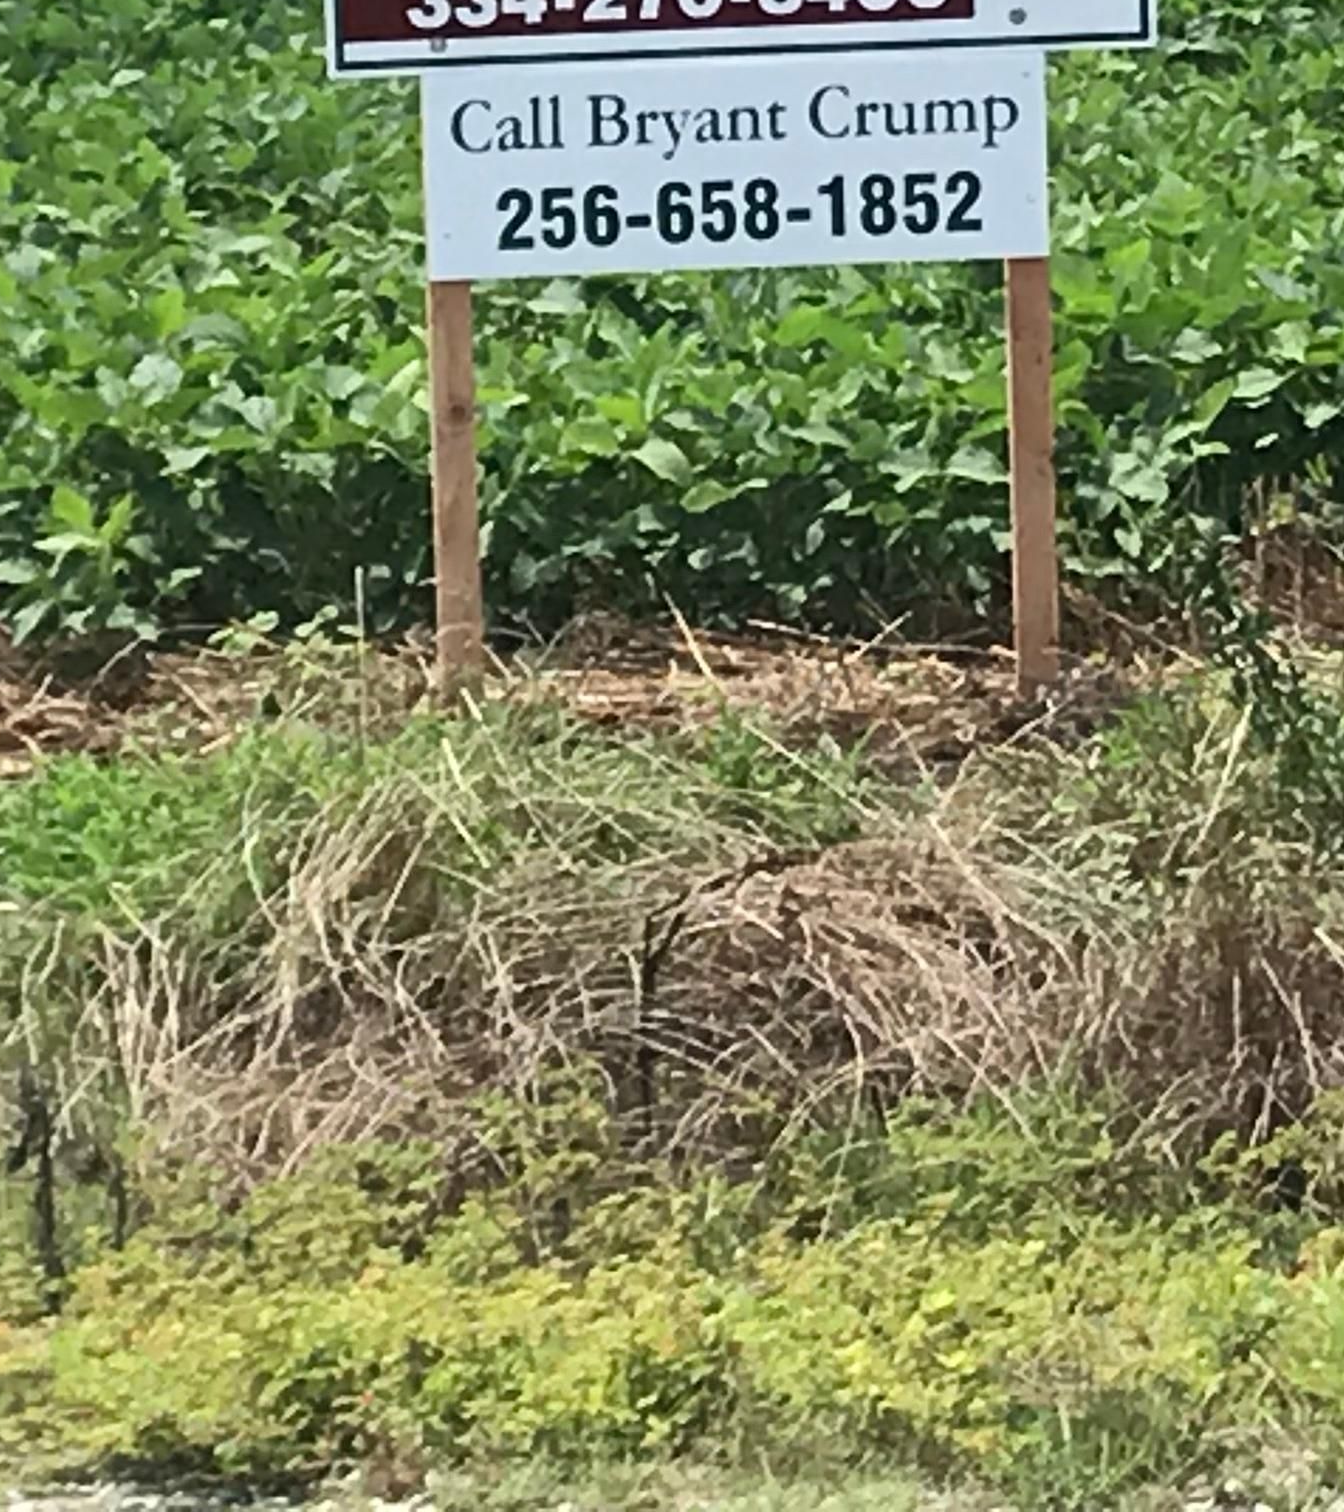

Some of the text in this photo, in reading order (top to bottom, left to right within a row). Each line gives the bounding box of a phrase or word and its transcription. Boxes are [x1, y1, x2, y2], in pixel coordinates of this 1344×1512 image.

[450, 84, 1020, 160] Call Bryant Crump
[496, 170, 983, 251] 256-658-1852
